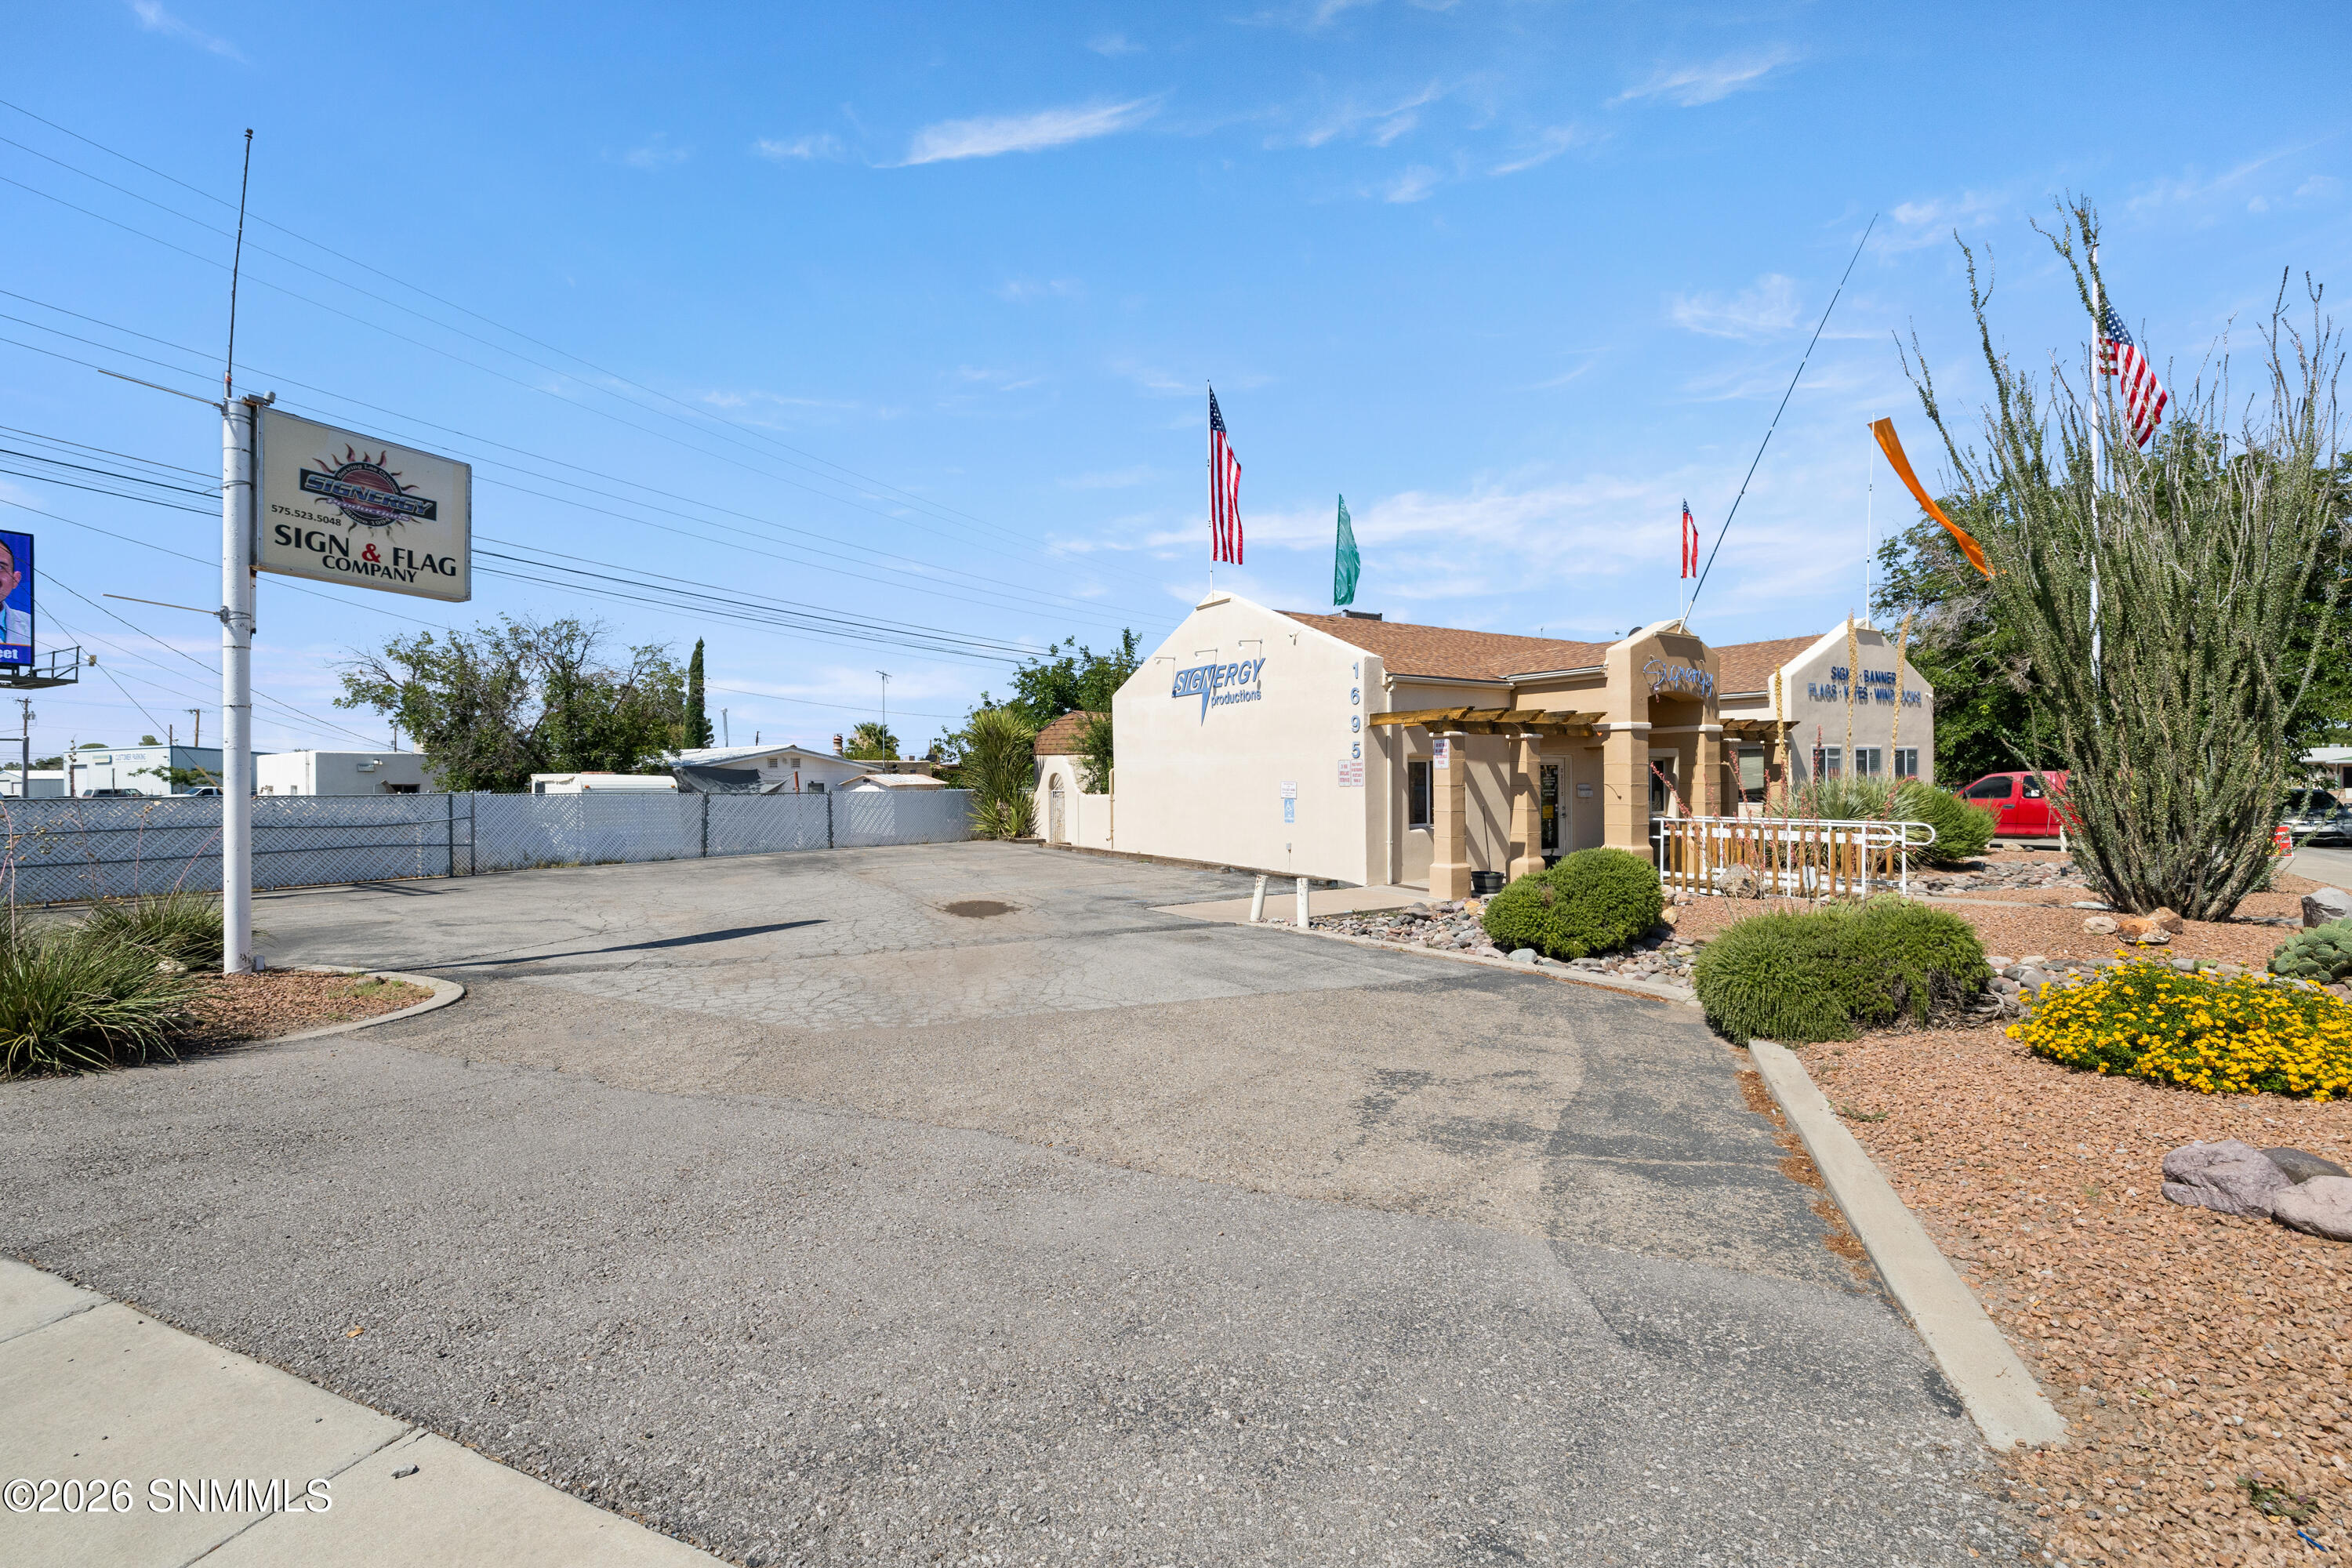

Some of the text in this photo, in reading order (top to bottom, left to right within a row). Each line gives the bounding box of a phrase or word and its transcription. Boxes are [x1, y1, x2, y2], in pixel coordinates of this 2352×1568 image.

[304, 474, 433, 515] SIGNERGY
[271, 504, 342, 527] 575.523.5048
[274, 524, 457, 576] SIGN & FLAG
[322, 555, 416, 583] COMPANY
[1171, 658, 1265, 697] SIGNERGY
[1643, 659, 1713, 697] Signergy
[1808, 682, 1837, 697] FLAGS
[1211, 691, 1261, 709] productions
